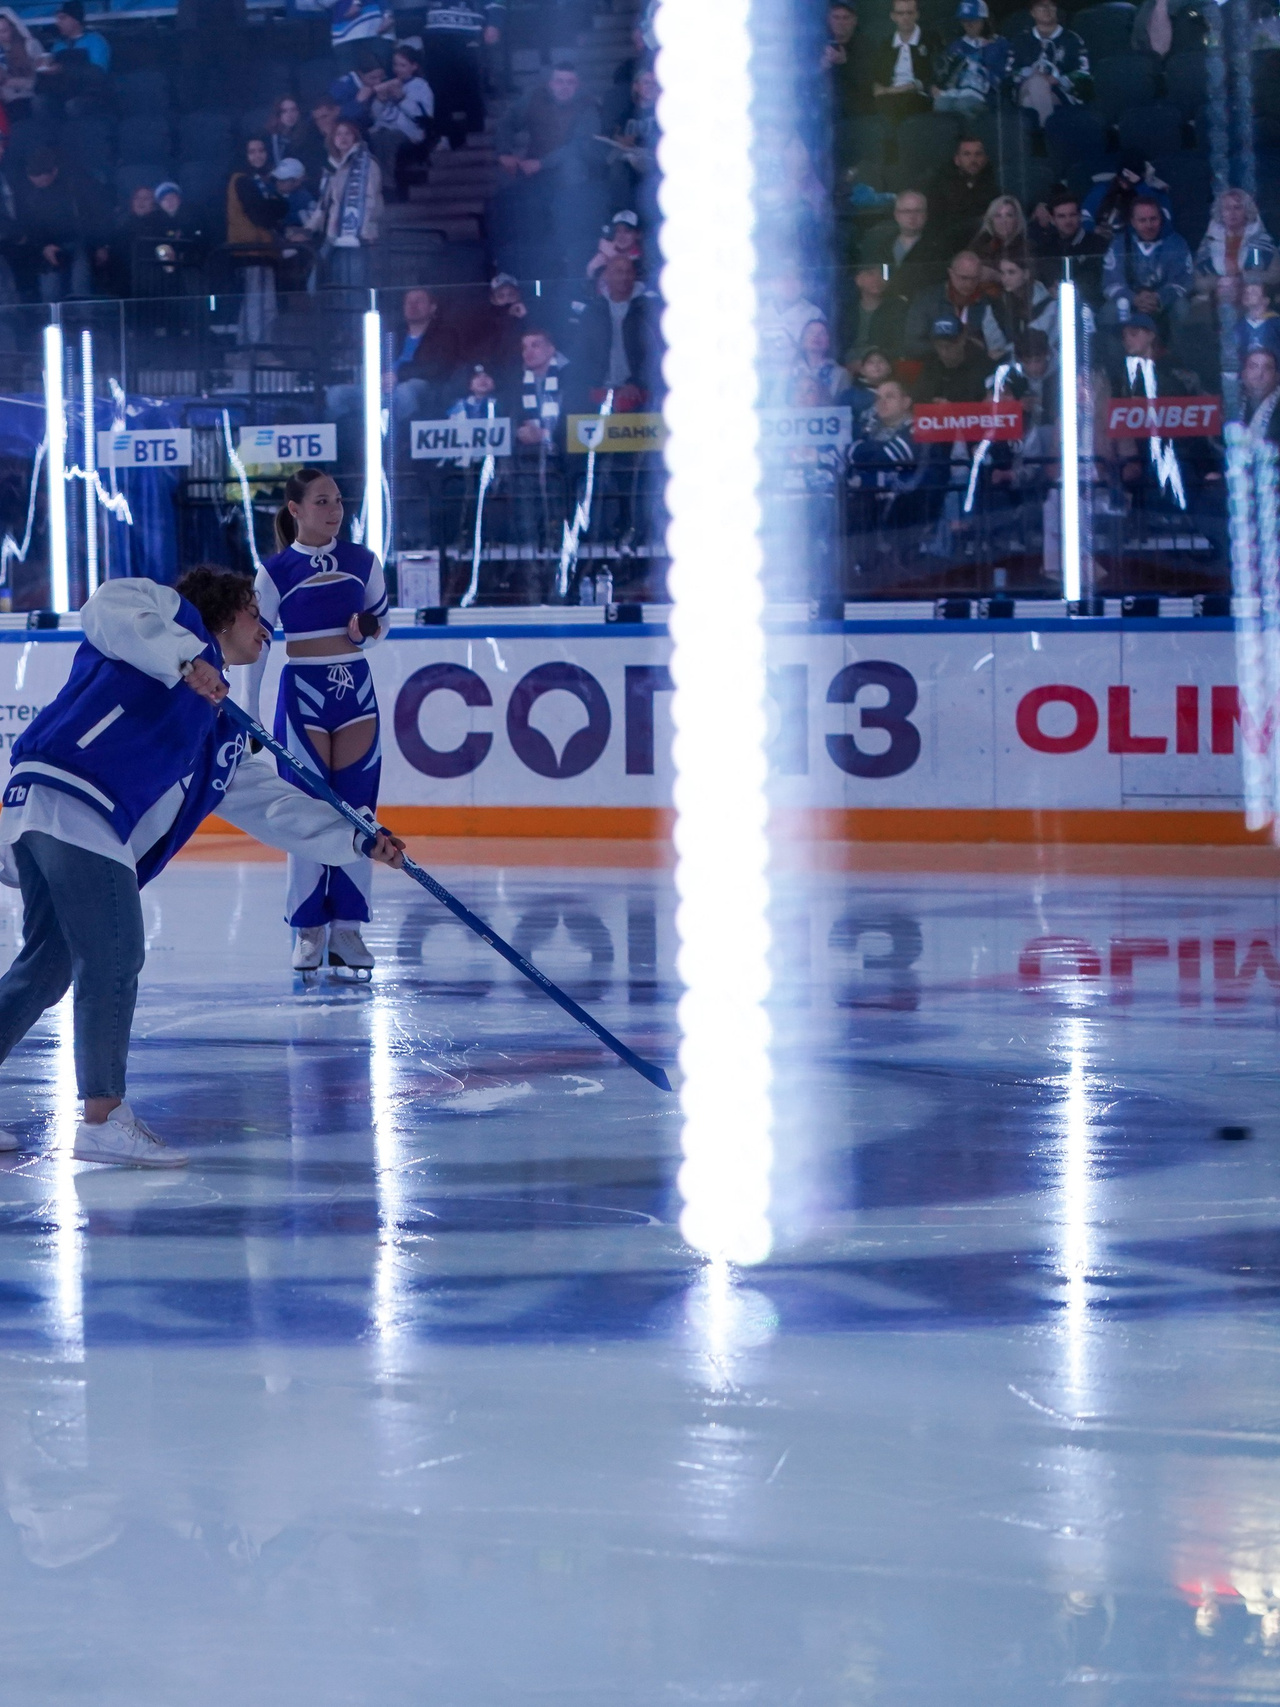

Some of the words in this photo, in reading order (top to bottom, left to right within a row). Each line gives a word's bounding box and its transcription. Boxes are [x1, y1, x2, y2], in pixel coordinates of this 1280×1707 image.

[918, 413, 1018, 430] OLIMPBET
[1110, 404, 1218, 429] FONBET
[417, 420, 506, 450] KHL.RU
[607, 426, 658, 439] БАНК
[133, 438, 178, 462] ВТБ
[276, 434, 322, 458] ВТБ
